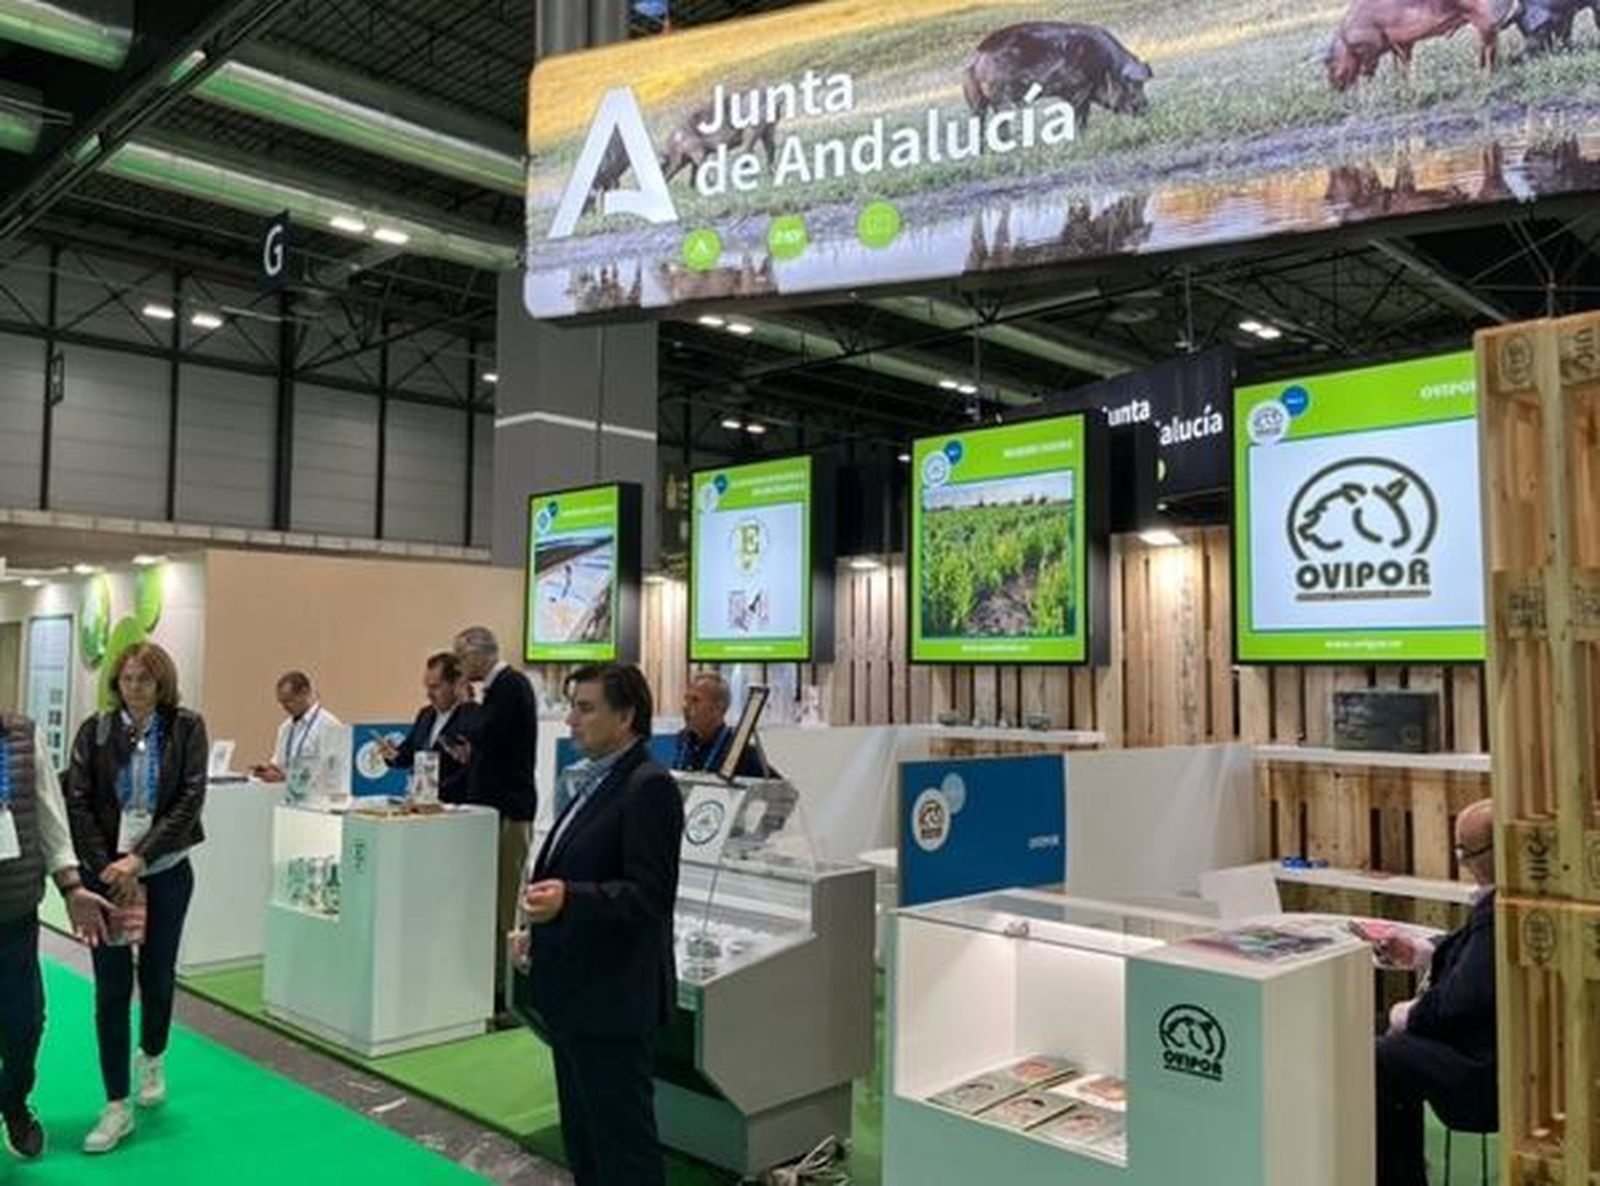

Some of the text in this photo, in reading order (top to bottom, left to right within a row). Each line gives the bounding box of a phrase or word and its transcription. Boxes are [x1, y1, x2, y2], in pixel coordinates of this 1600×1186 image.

[697, 69, 854, 134] Junta
[696, 82, 1075, 196] de Andalucía
[264, 224, 283, 277] G
[1102, 399, 1151, 427] unta
[1296, 558, 1430, 590] OVIPOR
[1163, 1049, 1222, 1076] OVIPOR
